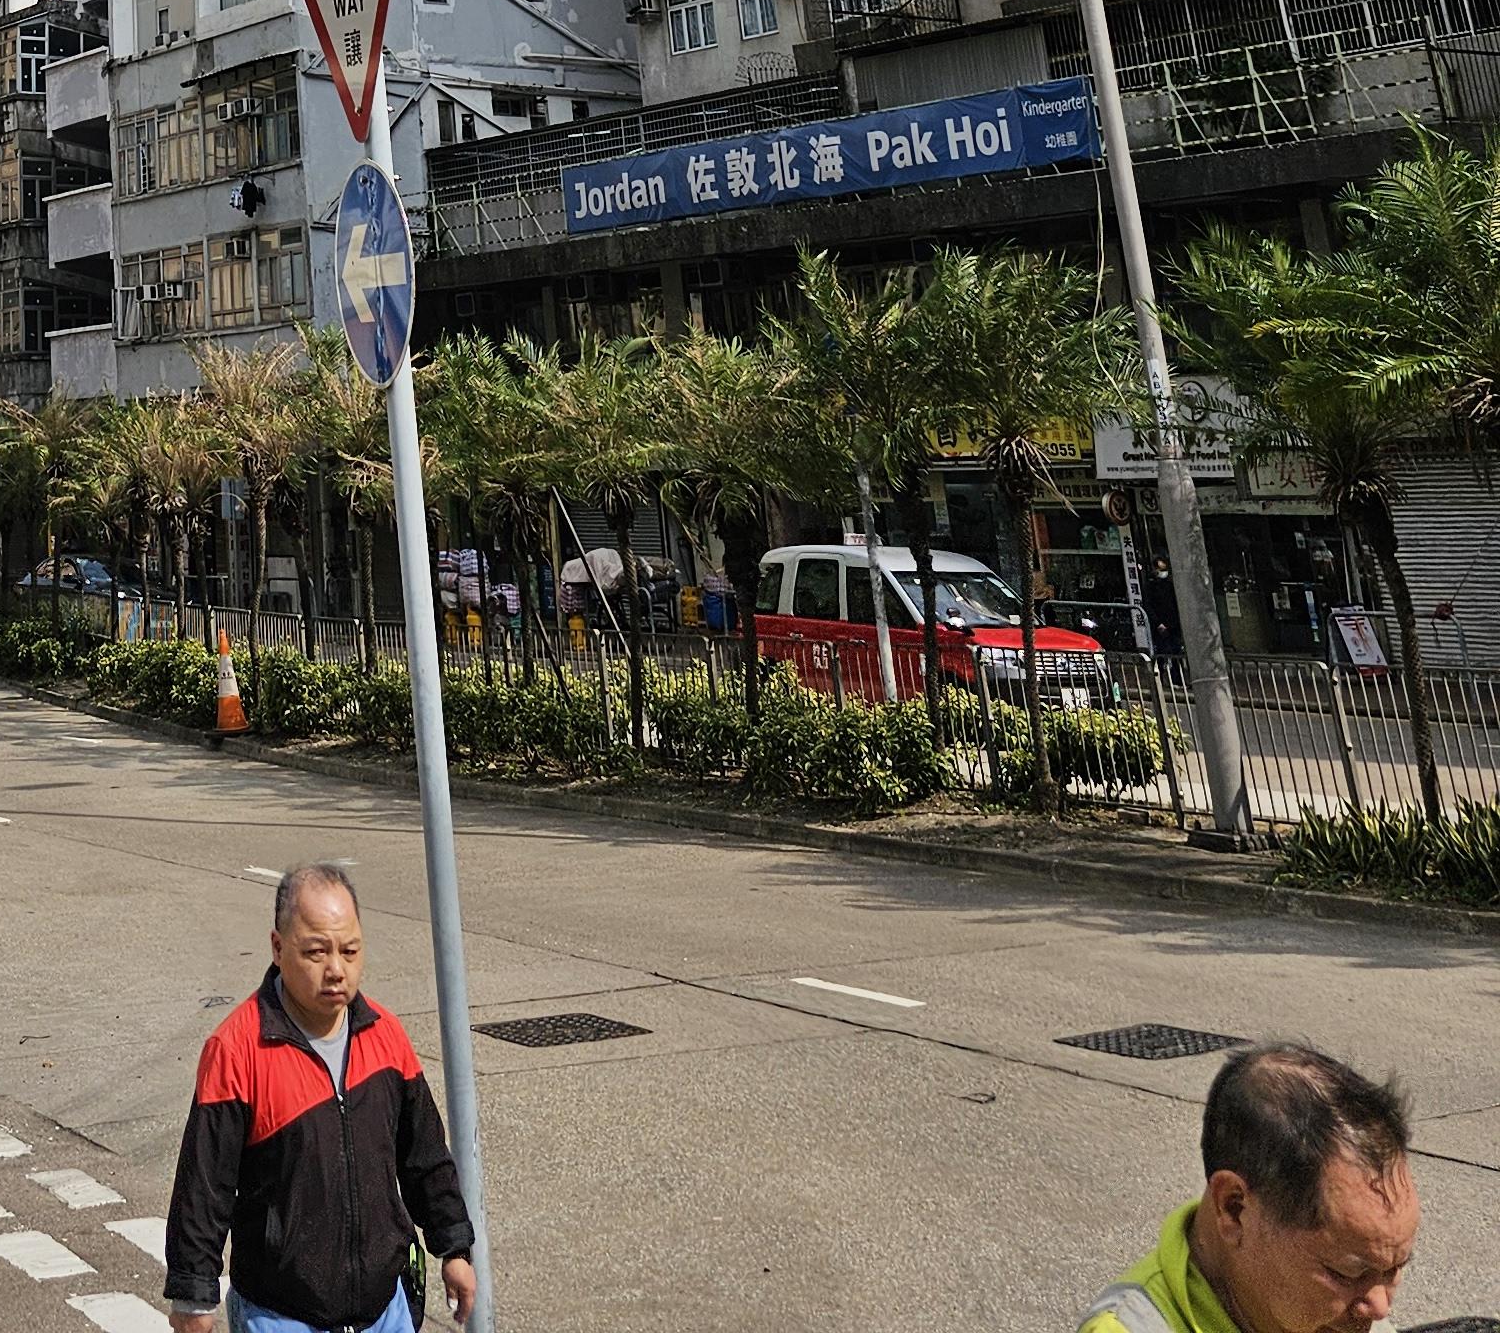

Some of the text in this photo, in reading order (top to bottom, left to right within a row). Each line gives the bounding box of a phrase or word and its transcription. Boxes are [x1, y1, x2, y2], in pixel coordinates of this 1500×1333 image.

[343, 29, 363, 67] 讓
[1021, 93, 1089, 119] Kindergarten
[1044, 130, 1079, 150] 幼稚園
[573, 107, 1012, 220] Jordan 佐敦北海 Pak Hoi
[1196, 449, 1217, 460] Food
